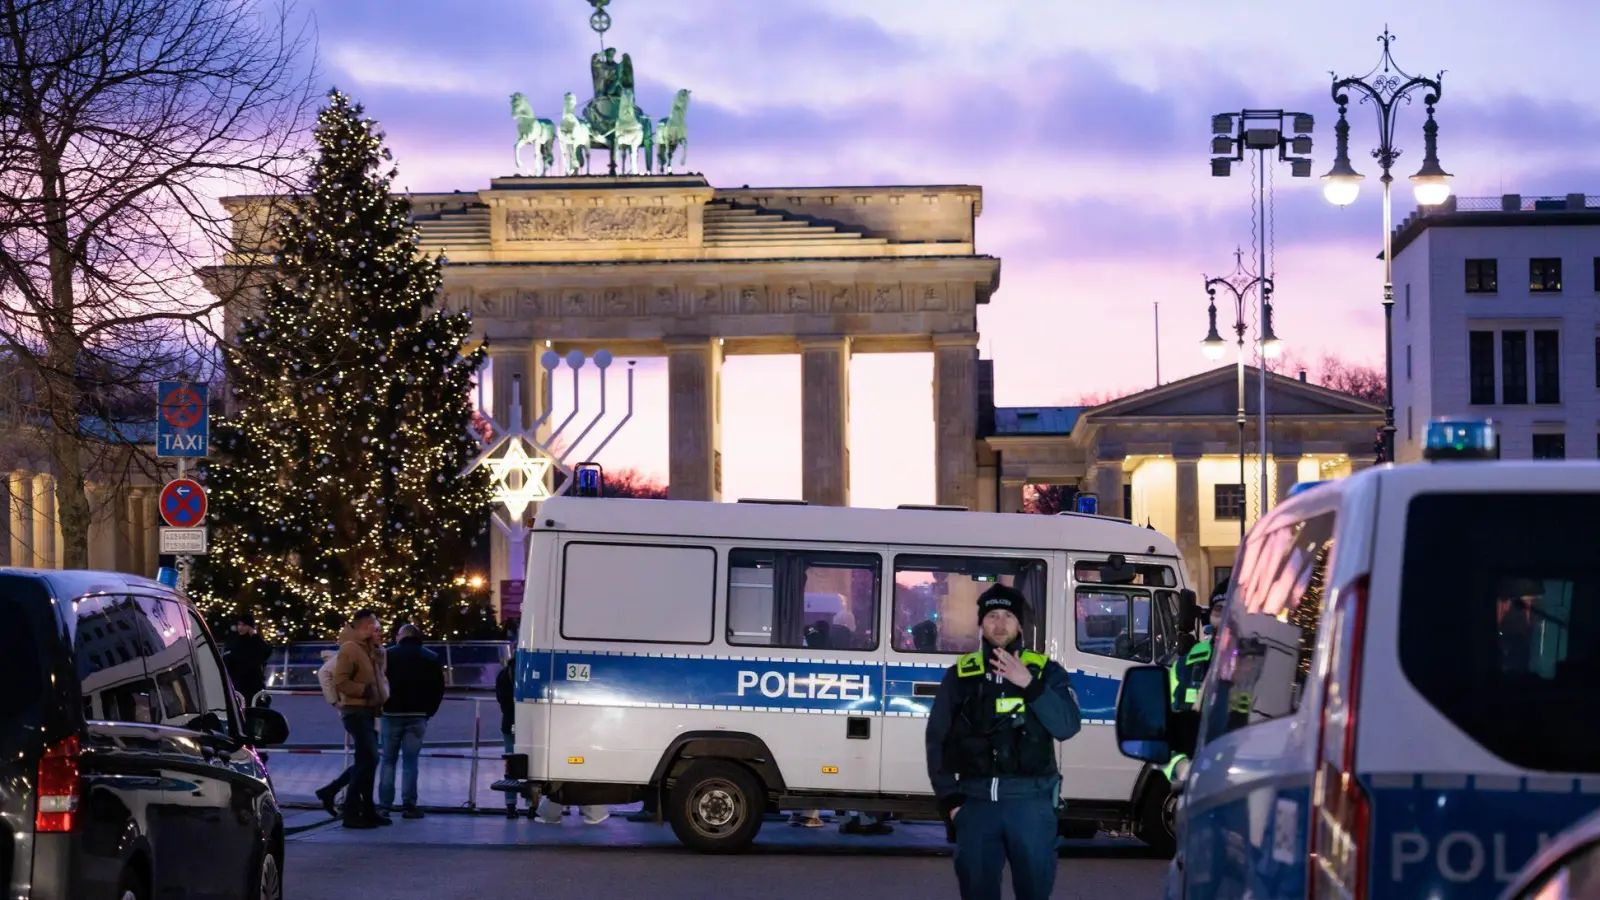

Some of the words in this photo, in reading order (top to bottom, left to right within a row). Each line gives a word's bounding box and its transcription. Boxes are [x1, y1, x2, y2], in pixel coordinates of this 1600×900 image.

[162, 433, 203, 450] TAXI
[985, 598, 1012, 607] POLIZEI
[737, 670, 871, 701] POLIZEI
